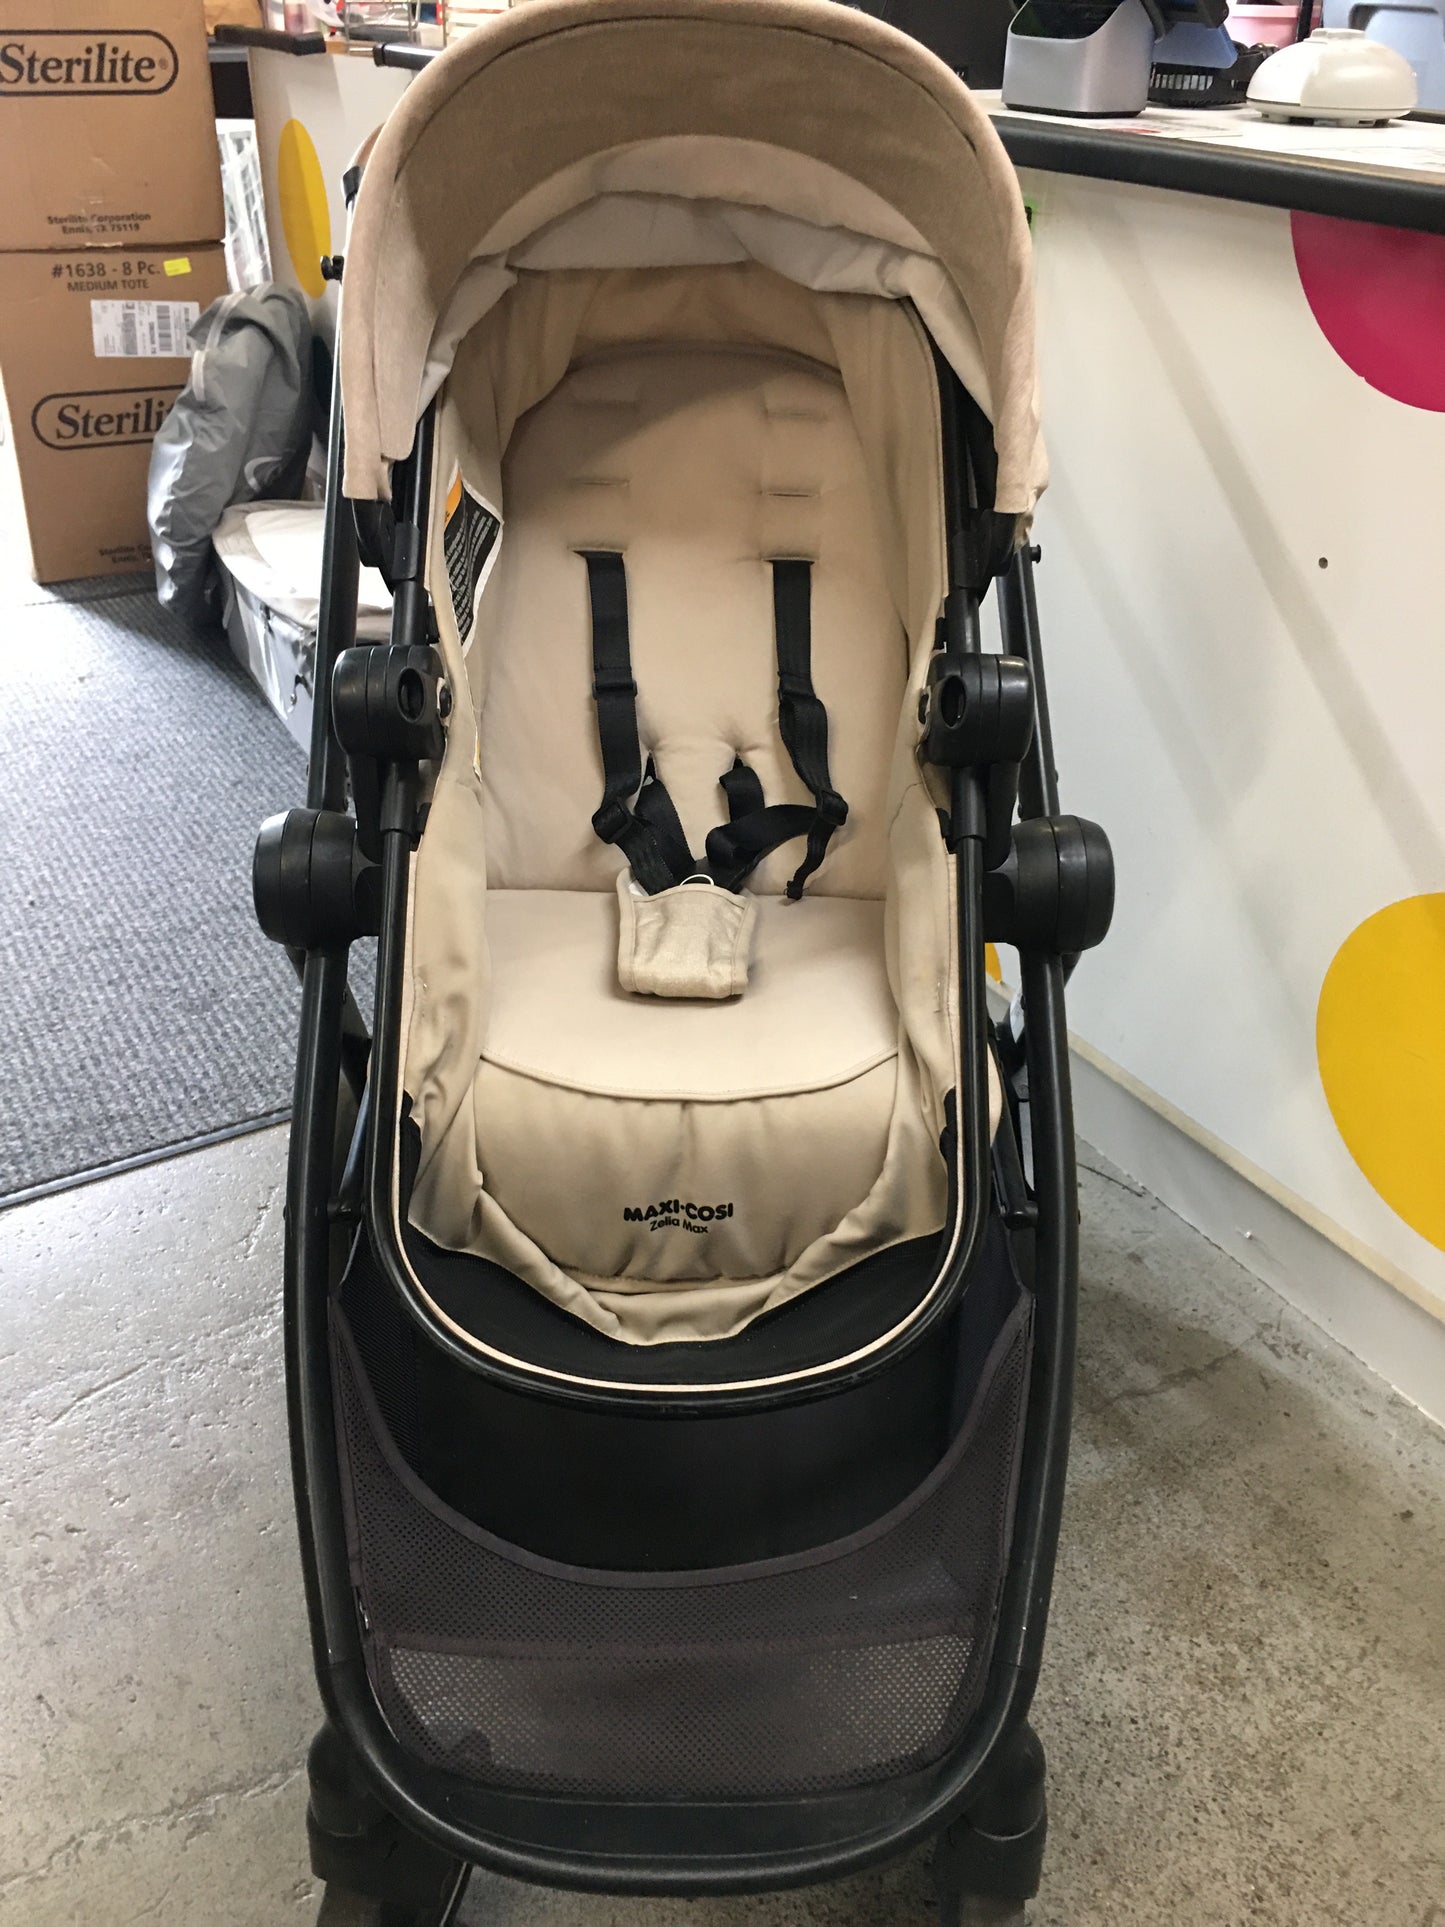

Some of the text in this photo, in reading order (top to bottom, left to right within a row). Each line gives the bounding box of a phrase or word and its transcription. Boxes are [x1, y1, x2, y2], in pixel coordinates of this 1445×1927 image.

[0, 42, 156, 84] Sterilite
[52, 262, 107, 278] #1638
[122, 261, 132, 276] 8
[137, 260, 160, 275] Pc.
[66, 278, 150, 292] MEDIUM TOTE
[56, 398, 174, 439] Sterili
[650, 1216, 709, 1234] Zelia Max
